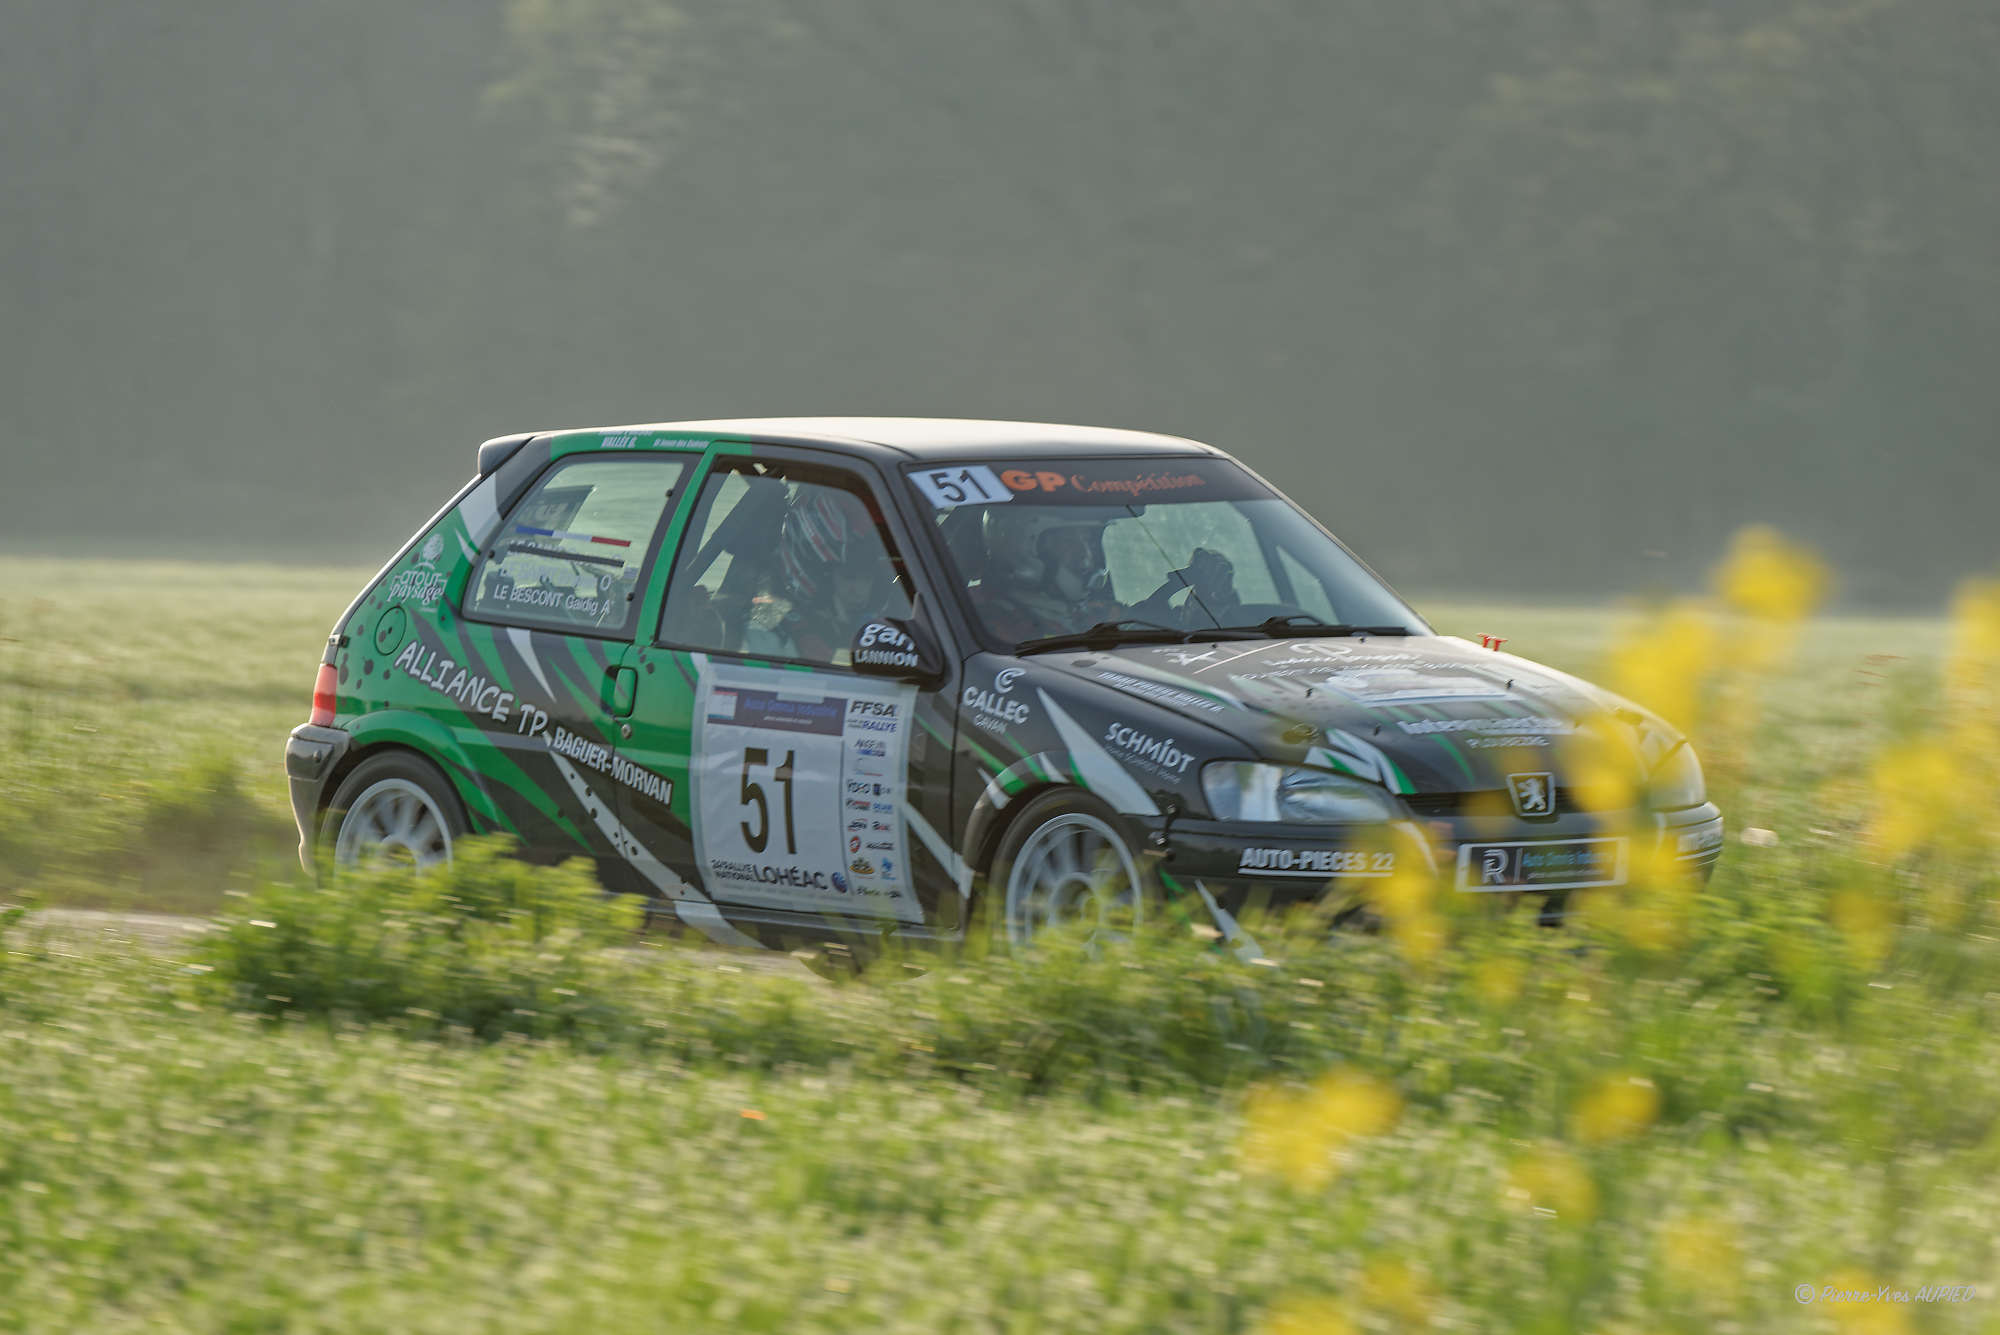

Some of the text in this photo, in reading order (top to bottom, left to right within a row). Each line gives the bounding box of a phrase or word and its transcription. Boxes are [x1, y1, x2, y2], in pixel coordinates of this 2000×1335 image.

[929, 469, 990, 501] 51
[1001, 470, 1066, 492] GP
[494, 584, 509, 600] LE
[510, 586, 563, 608] BESCONT
[860, 623, 915, 652] gan
[855, 649, 919, 668] LANNION
[394, 641, 548, 737] ALLIANCE TP
[849, 700, 897, 717] FFSA
[963, 686, 1029, 725] CALLEC
[553, 727, 673, 806] BAGUER-MORVAN
[741, 747, 797, 855] 51
[1370, 852, 1395, 871] 22
[752, 864, 829, 891] LOHÉAC
